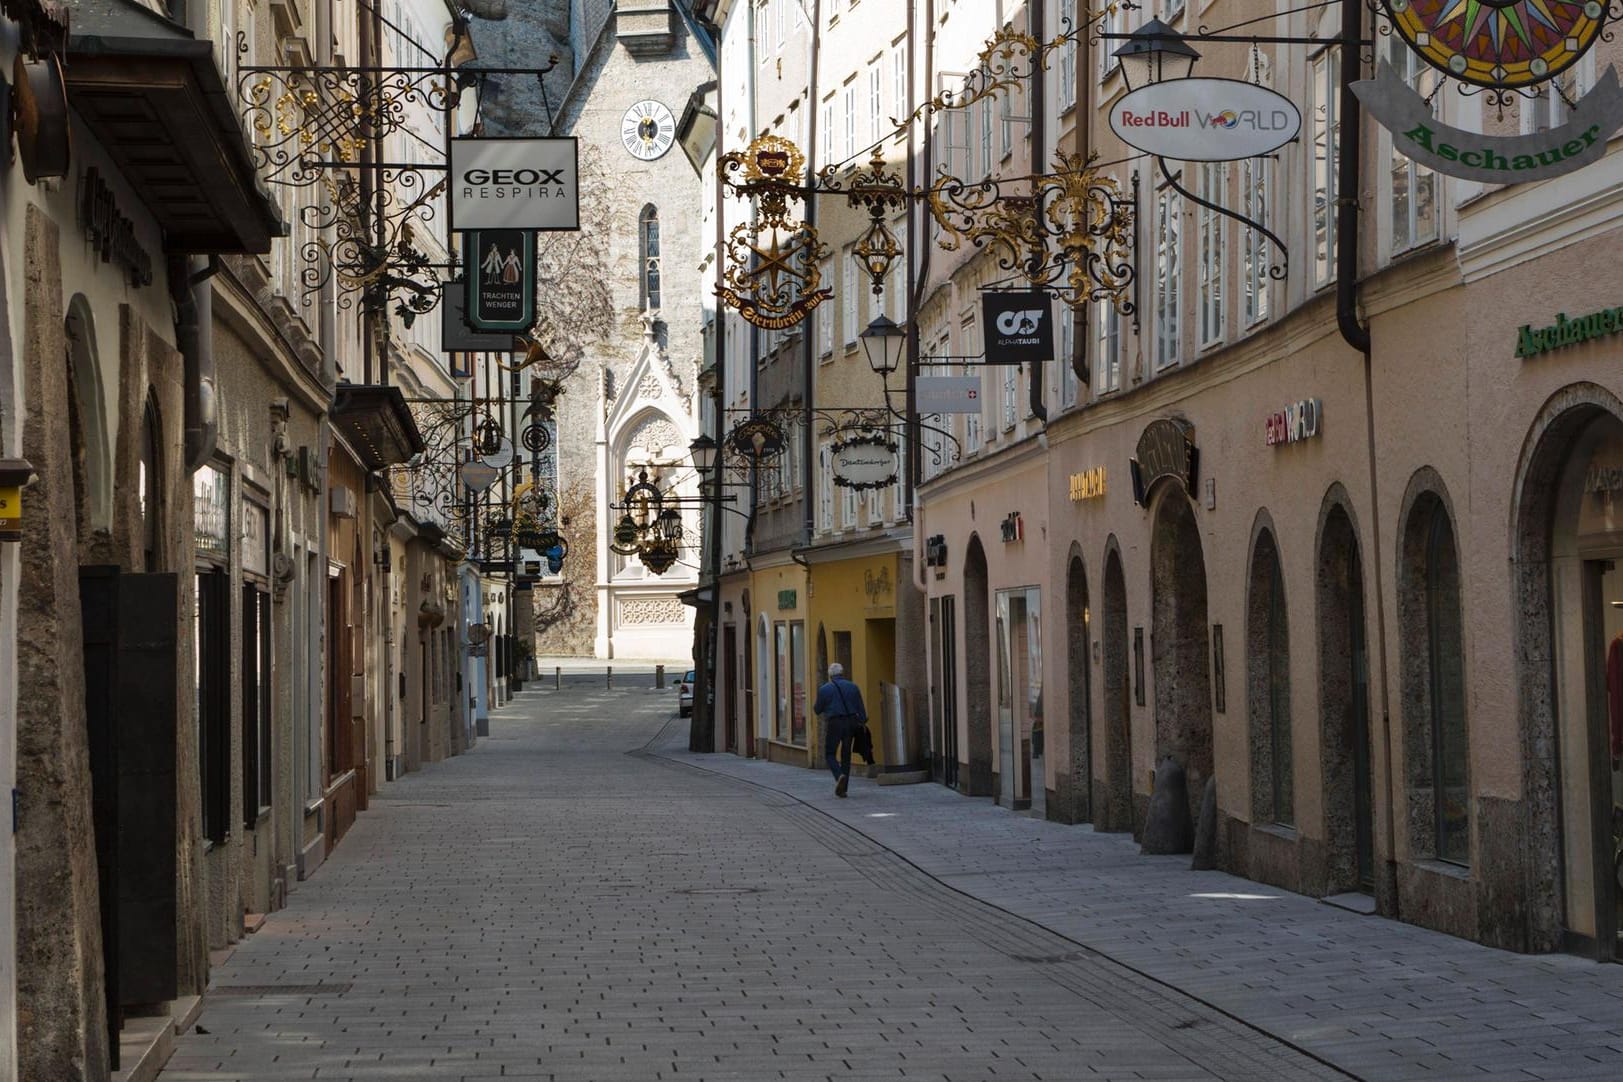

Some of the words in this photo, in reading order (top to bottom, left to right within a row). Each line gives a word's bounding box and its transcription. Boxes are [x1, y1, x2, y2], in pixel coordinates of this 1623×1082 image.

[1122, 111, 1155, 127] Red
[1158, 111, 1190, 127] Bull
[1195, 109, 1288, 131] WORLD
[1403, 122, 1601, 171] Aschauer
[464, 169, 565, 186] GEOX
[464, 187, 566, 198] RESPIRA
[482, 292, 521, 300] TRACHTEN
[485, 301, 517, 309] WENGER
